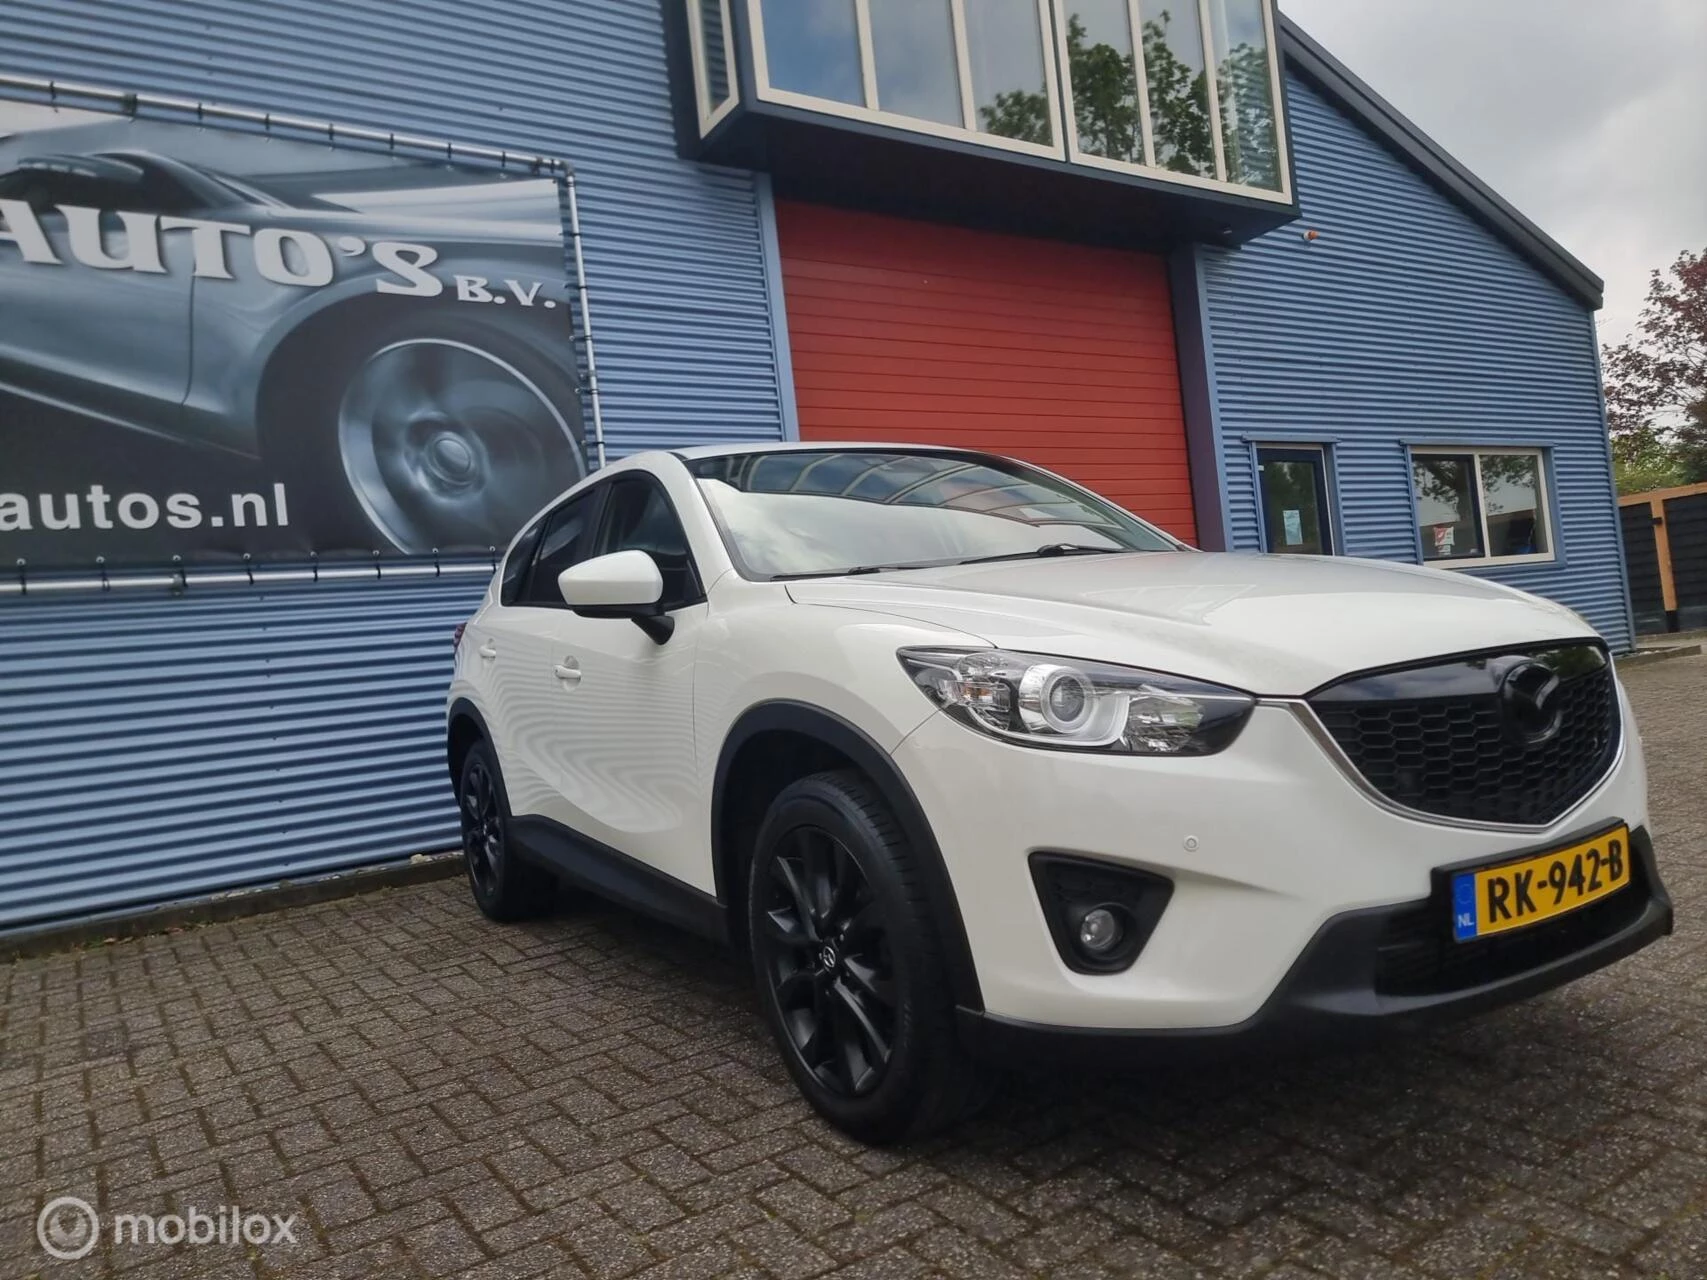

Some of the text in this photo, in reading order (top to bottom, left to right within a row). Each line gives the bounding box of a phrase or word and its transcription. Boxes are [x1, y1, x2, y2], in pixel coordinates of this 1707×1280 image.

[456, 275, 557, 309] B.V.
[0, 483, 289, 531] autos.nl
[1487, 839, 1624, 924] RK-942-B
[1458, 913, 1475, 928] NL
